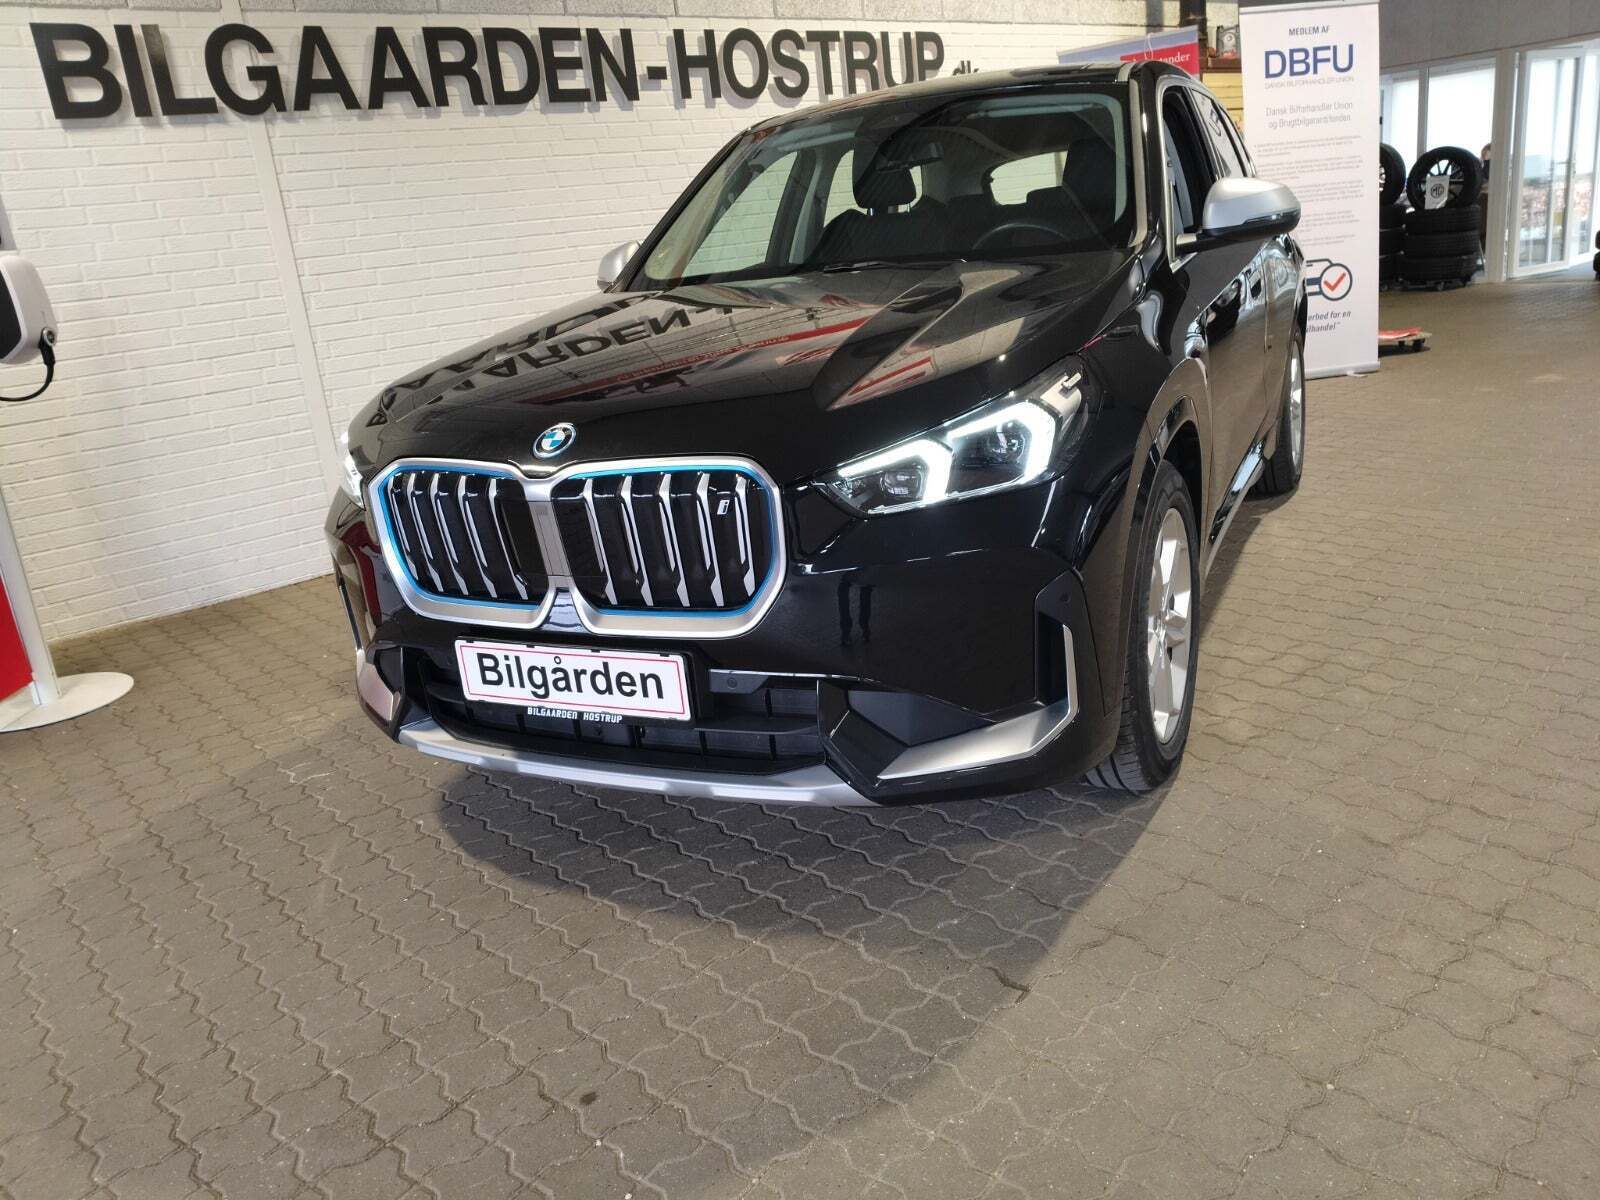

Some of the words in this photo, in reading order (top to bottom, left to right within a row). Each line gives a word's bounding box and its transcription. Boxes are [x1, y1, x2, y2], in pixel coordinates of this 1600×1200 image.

[1288, 26, 1320, 36] MEDLEM
[1321, 25, 1331, 33] AF
[1264, 44, 1354, 79] DBFU
[476, 652, 664, 699] Bilgården
[527, 706, 578, 720] BILGAARDEN
[583, 712, 623, 724] HOSTRUP
